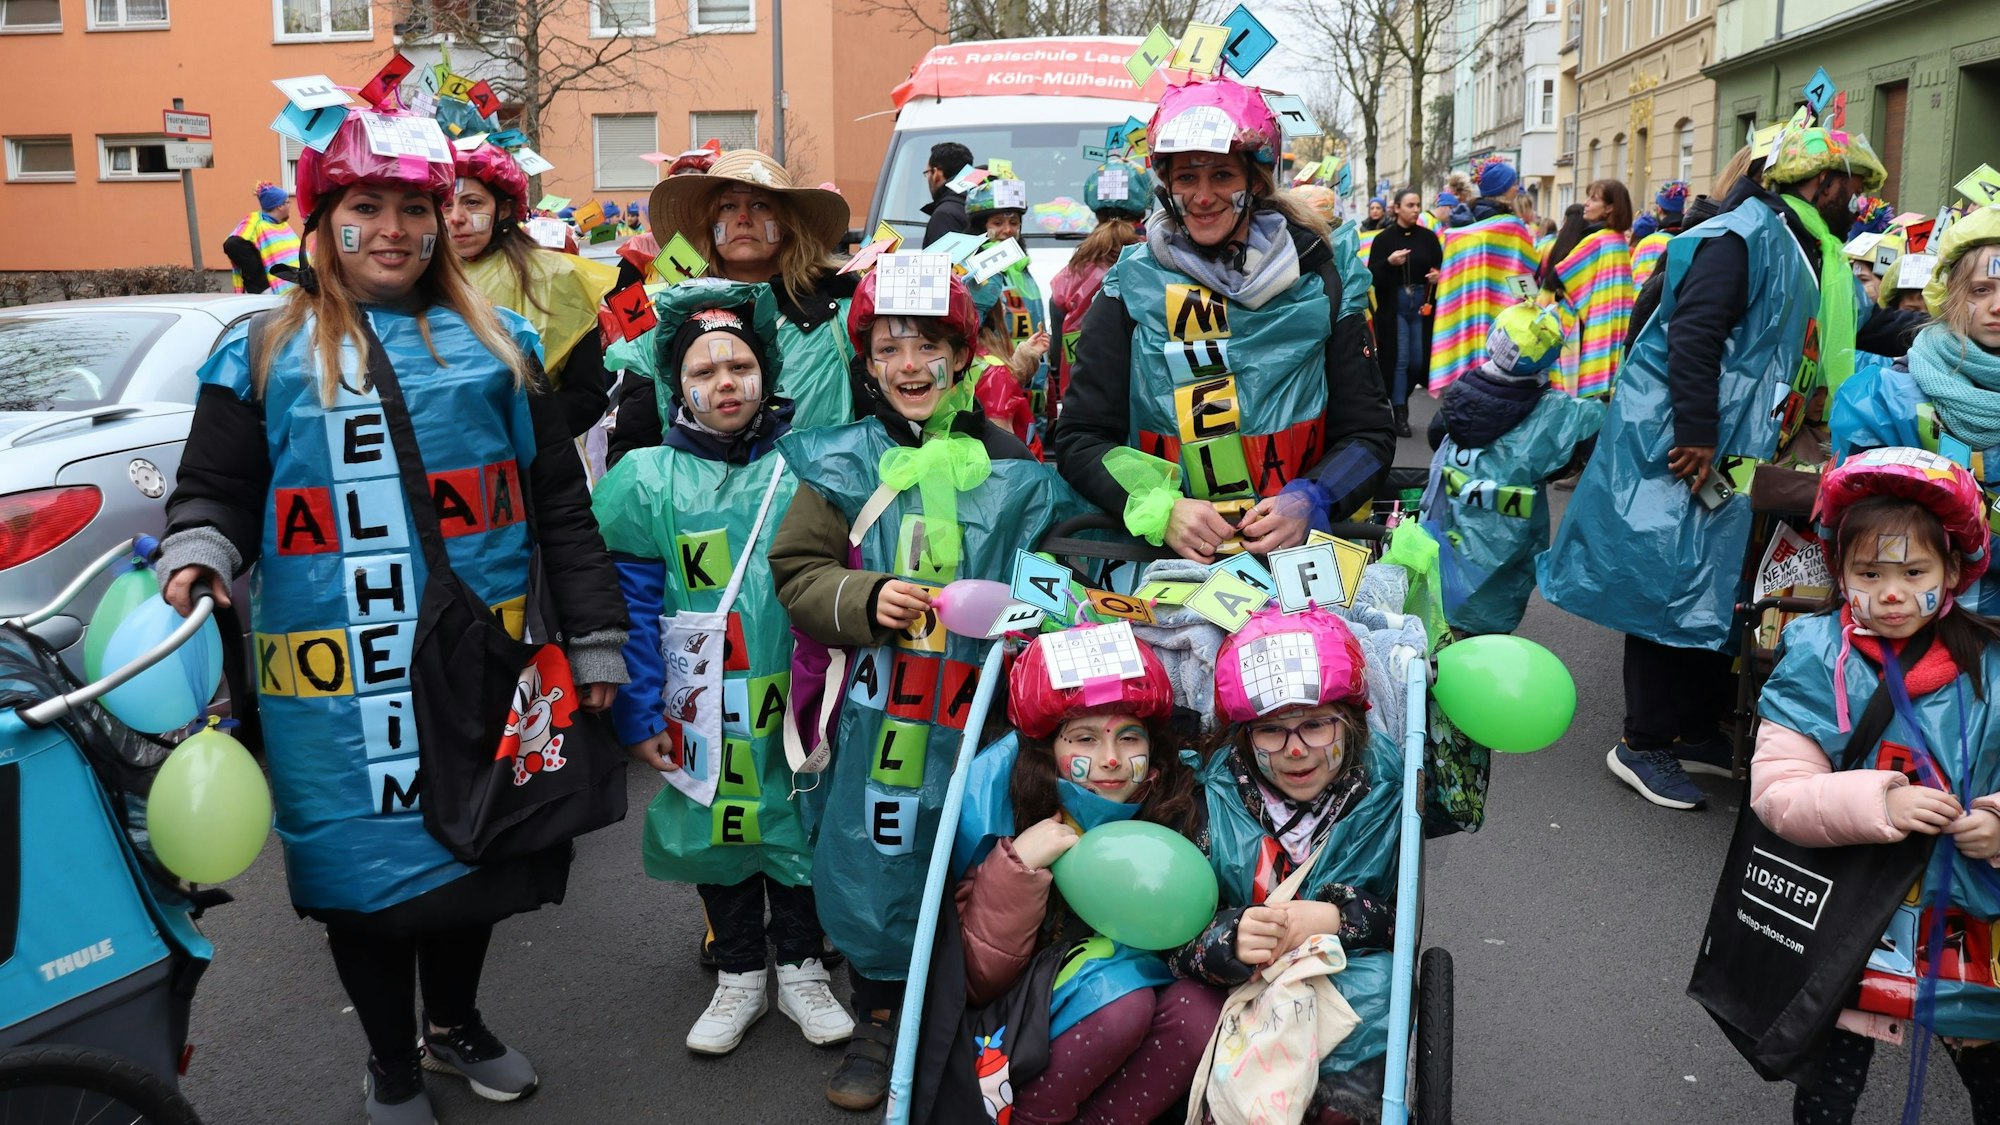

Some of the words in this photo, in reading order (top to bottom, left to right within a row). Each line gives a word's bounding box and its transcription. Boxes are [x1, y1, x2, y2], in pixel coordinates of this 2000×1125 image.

[965, 50, 1077, 65] Realschule
[986, 71, 1134, 89] Köln-Mülheim
[343, 229, 354, 248] E
[910, 257, 918, 307] ALAAF
[937, 364, 946, 380] A
[1763, 558, 1793, 585] NEW
[1796, 544, 1823, 563] YOR
[1029, 576, 1060, 602] A
[1297, 561, 1319, 597] F
[1008, 608, 1040, 623] E
[1213, 590, 1252, 618] A
[1852, 595, 1863, 613] A
[684, 735, 697, 772] N
[1072, 758, 1088, 779] S
[1745, 861, 1818, 908] SIDESTEP
[1736, 907, 1805, 956] idestep-shoes.com
[39, 937, 115, 982] THULE
